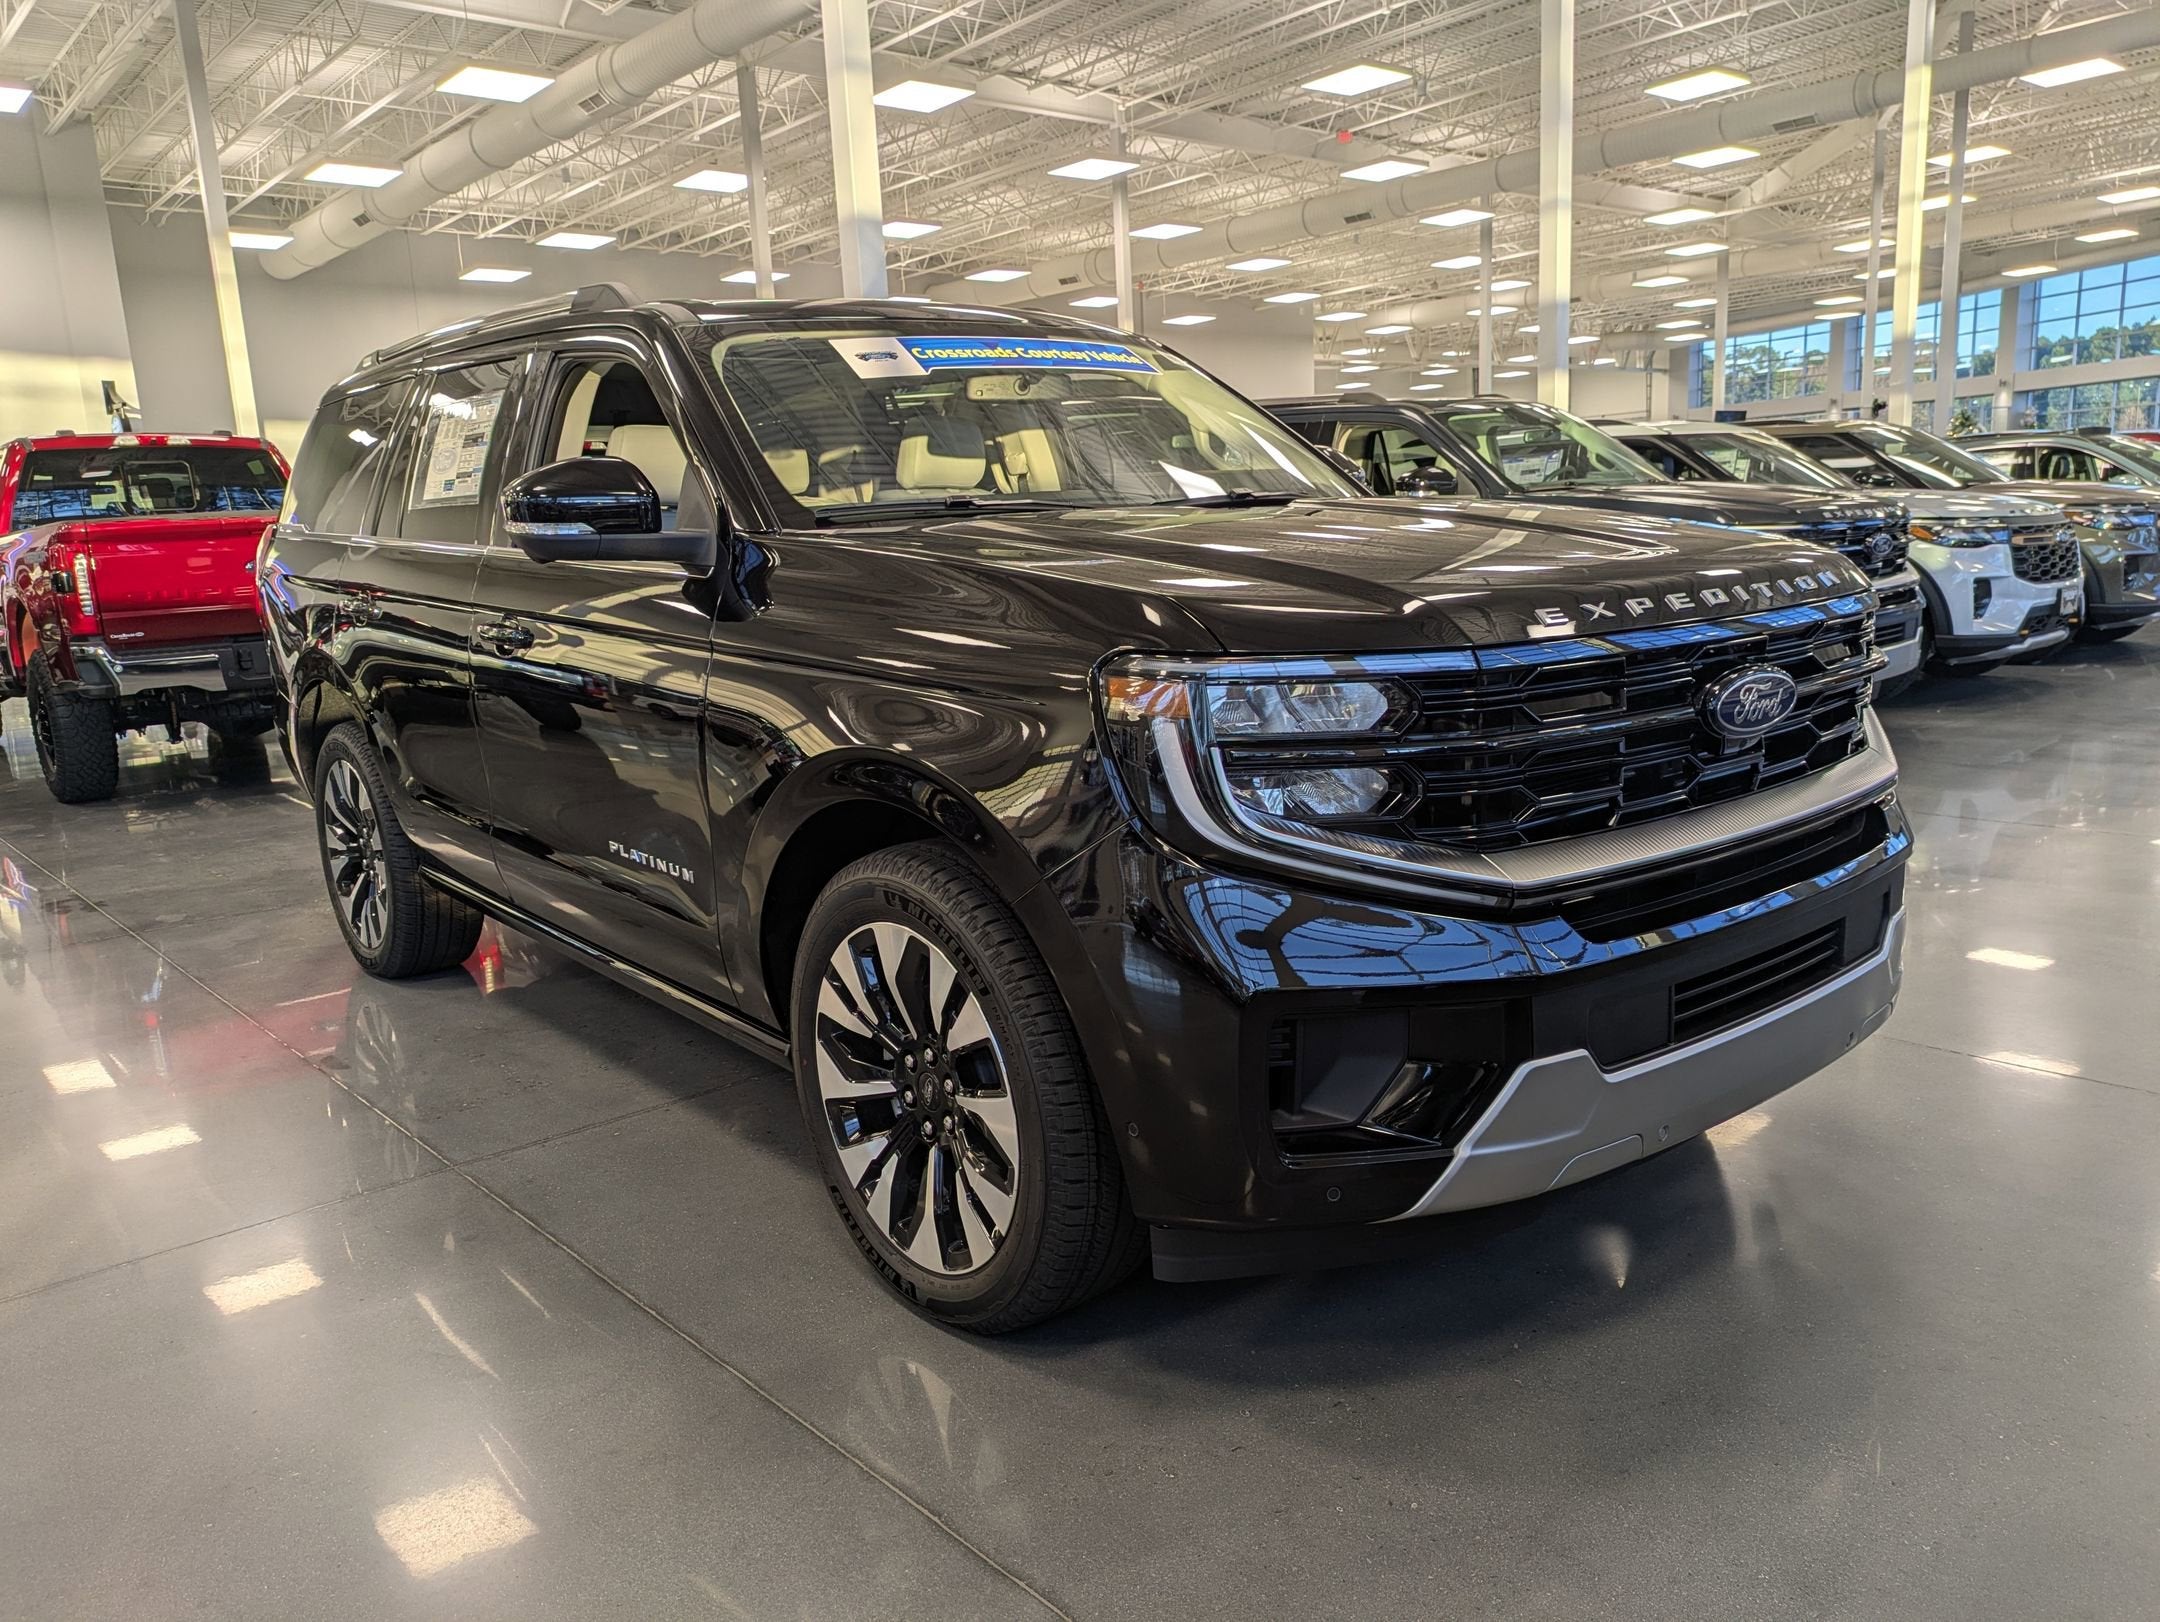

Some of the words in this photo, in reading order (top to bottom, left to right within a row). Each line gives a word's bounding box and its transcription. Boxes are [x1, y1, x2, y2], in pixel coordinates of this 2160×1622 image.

[911, 346, 1018, 360] Crossroads
[1018, 346, 1091, 362] Courtesy
[1087, 350, 1143, 365] Vehicle
[1534, 570, 1841, 627] EXPEDITION
[1734, 681, 1786, 723] Ford
[608, 840, 695, 884] PLATINUM
[907, 902, 985, 993] MICHELIN
